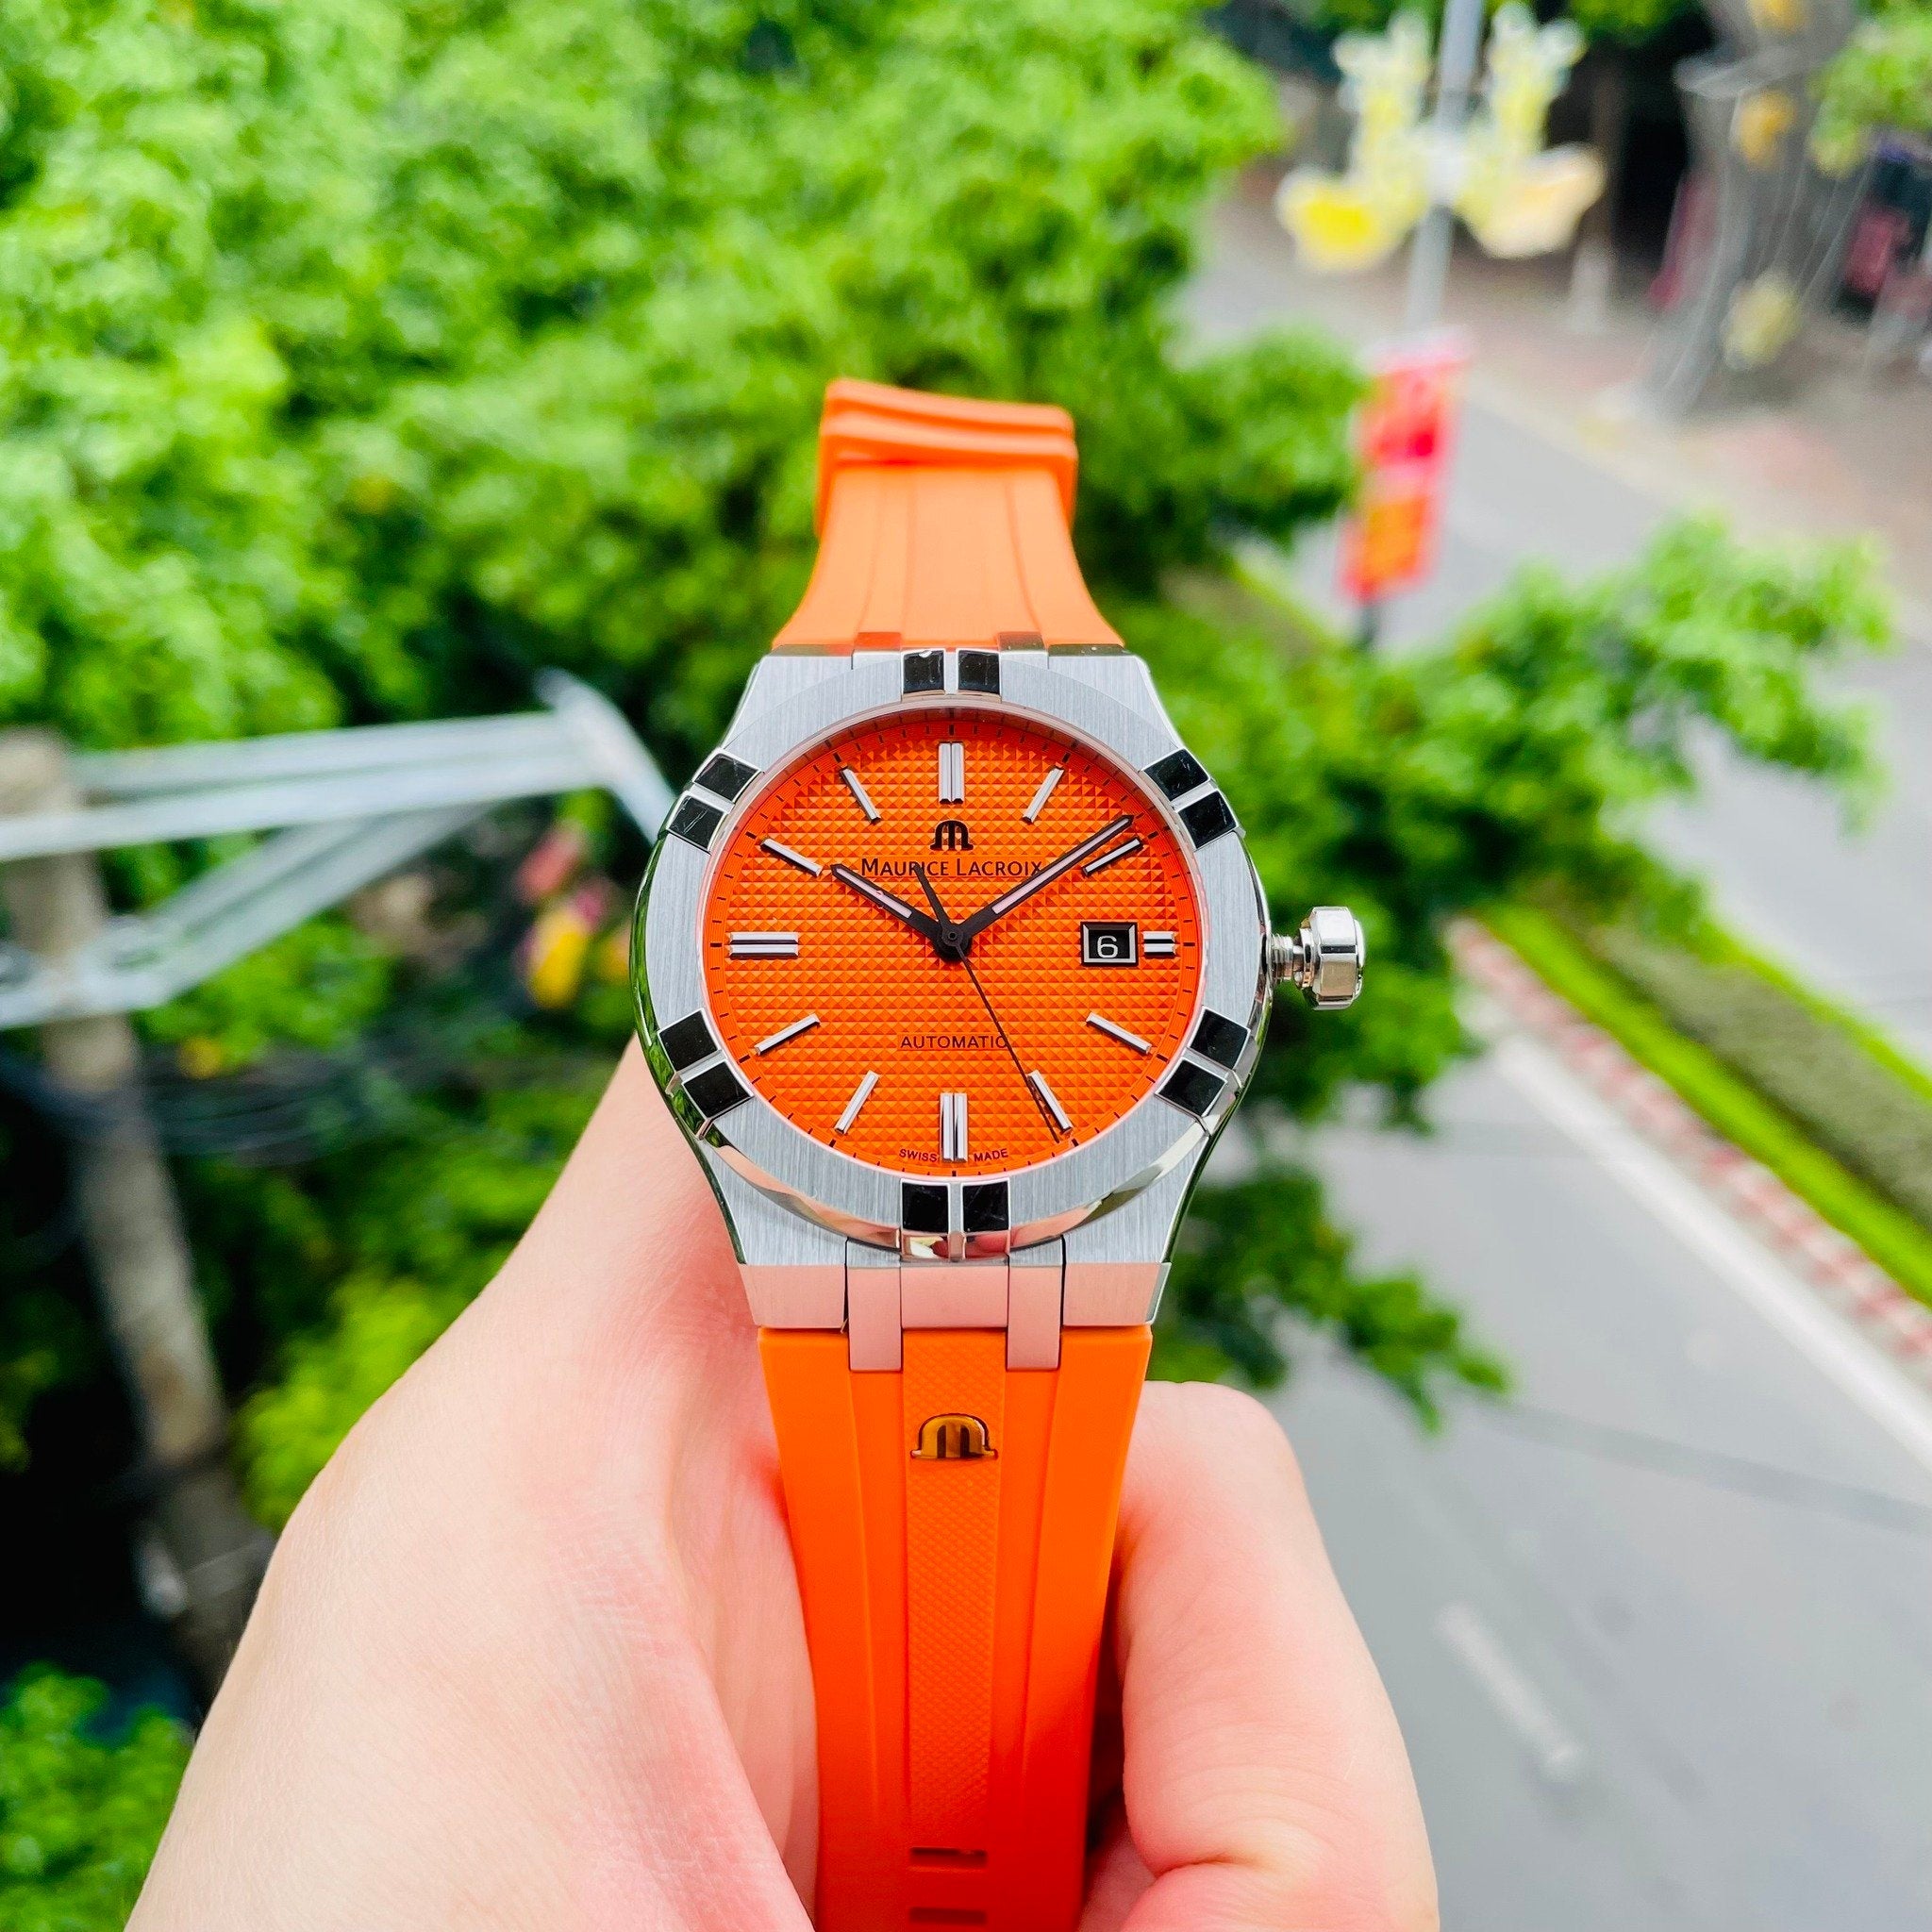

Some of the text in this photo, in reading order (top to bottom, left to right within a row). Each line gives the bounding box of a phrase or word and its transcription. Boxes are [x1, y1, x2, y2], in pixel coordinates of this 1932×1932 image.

[861, 858, 1042, 876] MAURICE LACROIX
[1096, 935, 1119, 958] 6
[900, 1035, 1008, 1049] AUTOMATIC
[899, 1148, 1008, 1162] SWISS MADE
